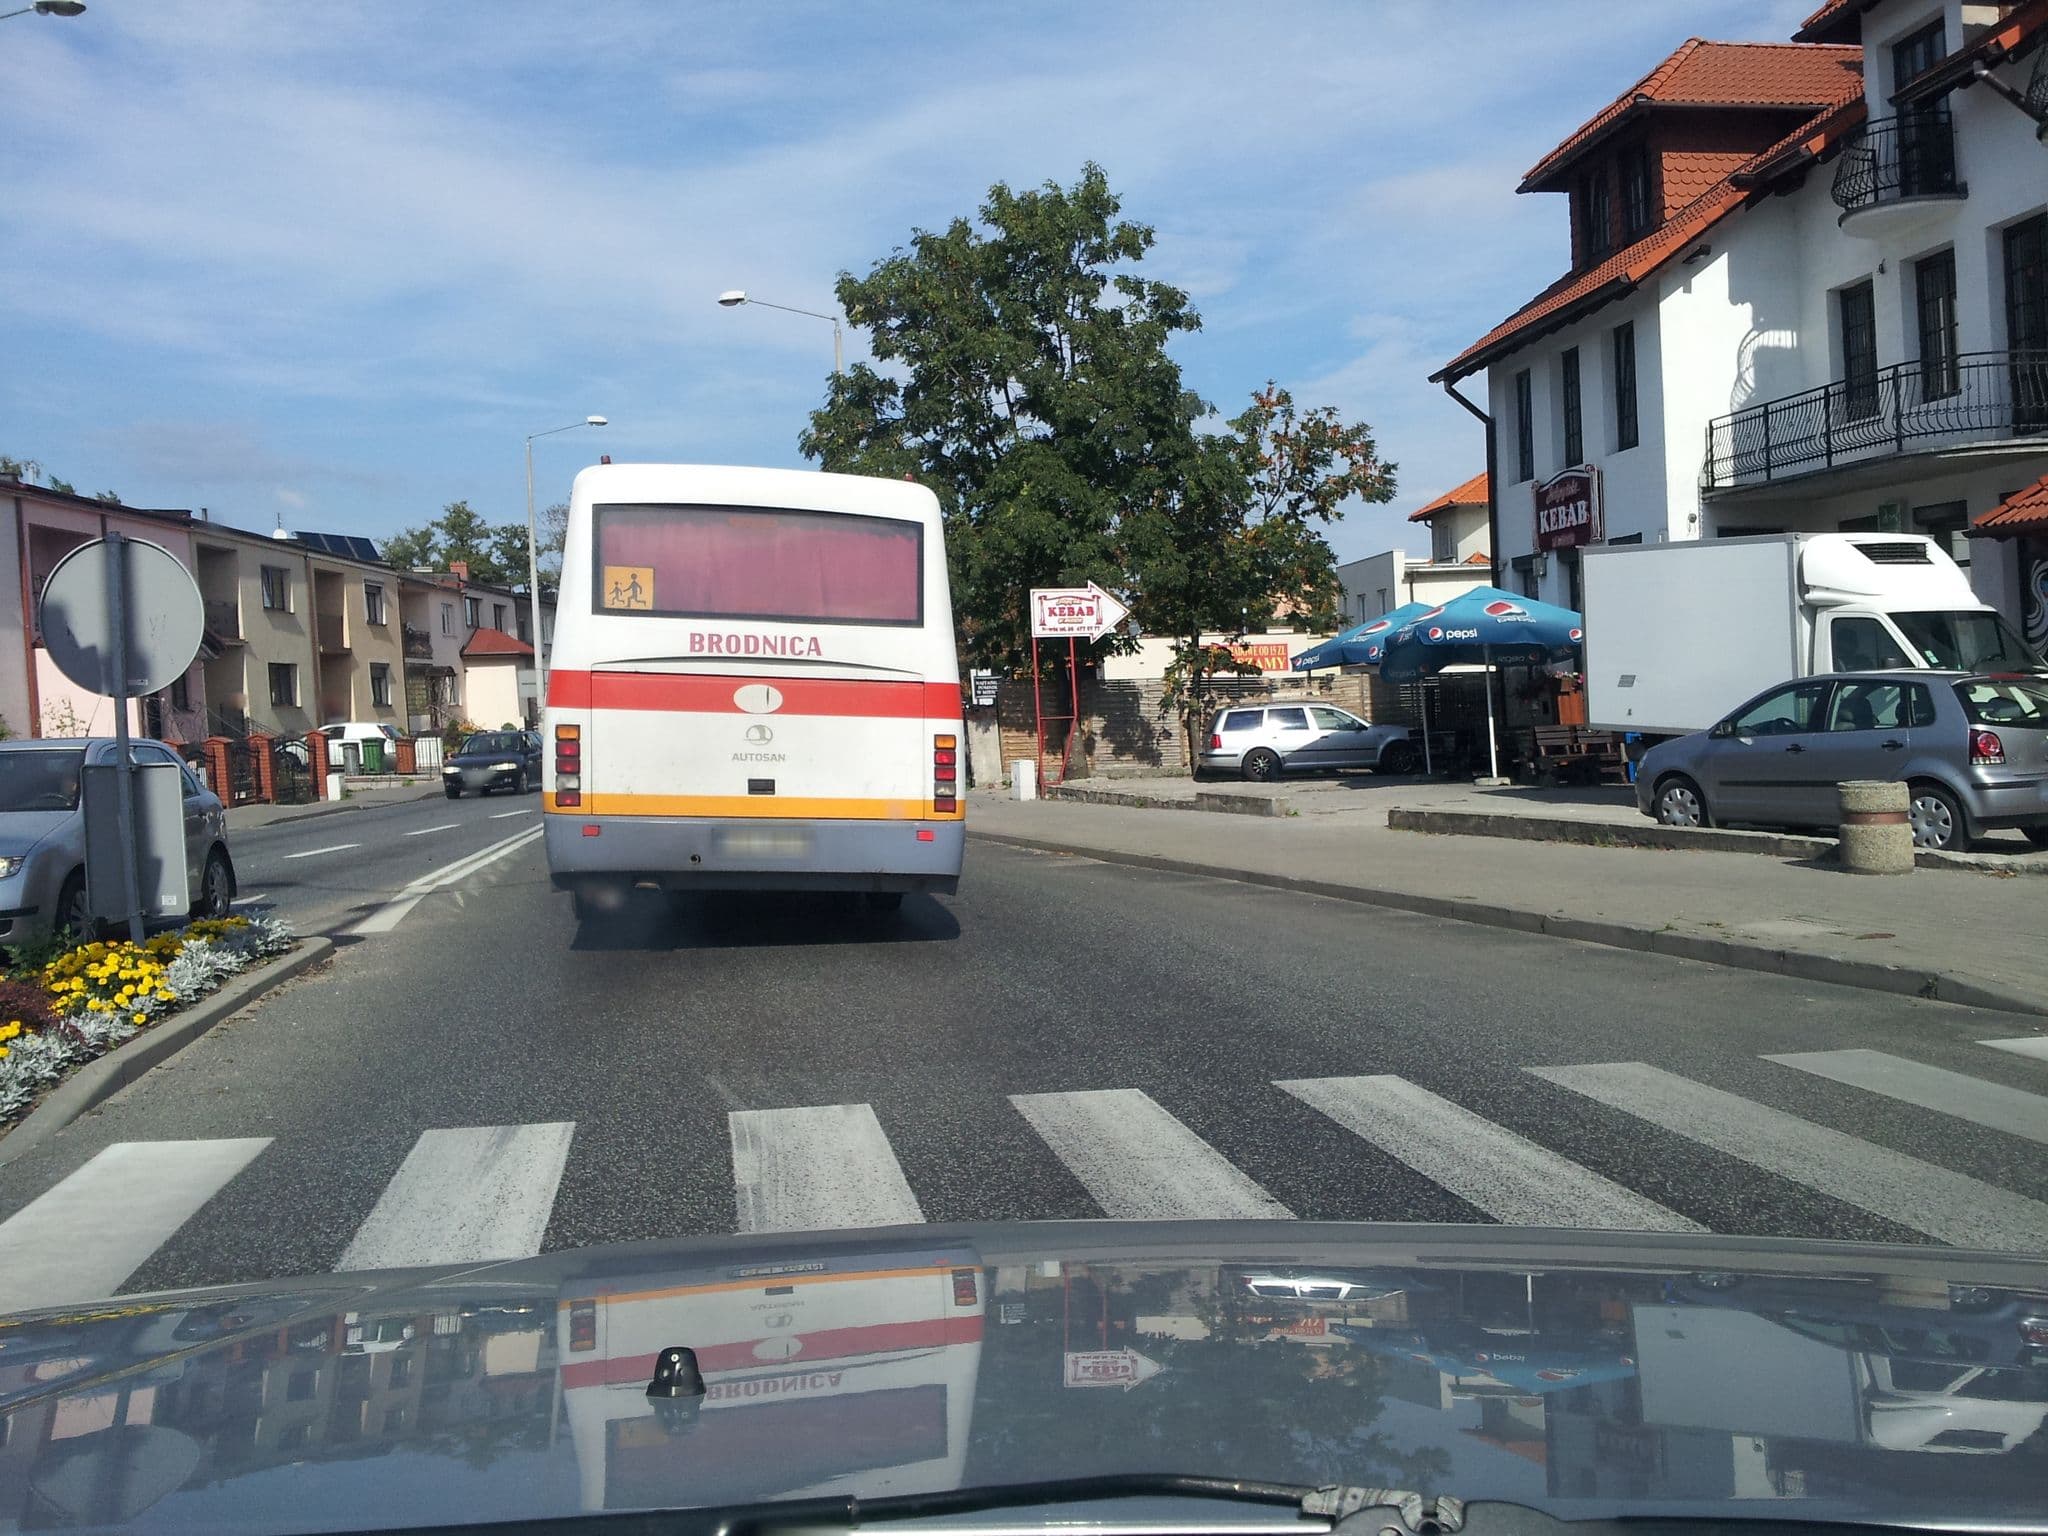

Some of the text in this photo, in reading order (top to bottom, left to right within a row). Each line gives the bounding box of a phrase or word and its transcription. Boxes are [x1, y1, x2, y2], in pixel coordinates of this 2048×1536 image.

[1540, 500, 1587, 534] KEBAB
[1047, 606, 1095, 617] KEBAB
[1446, 628, 1478, 640] pepsi
[689, 632, 822, 657] BRODNICA
[1302, 654, 1320, 665] pepsi
[731, 752, 786, 762] AUTOSAN
